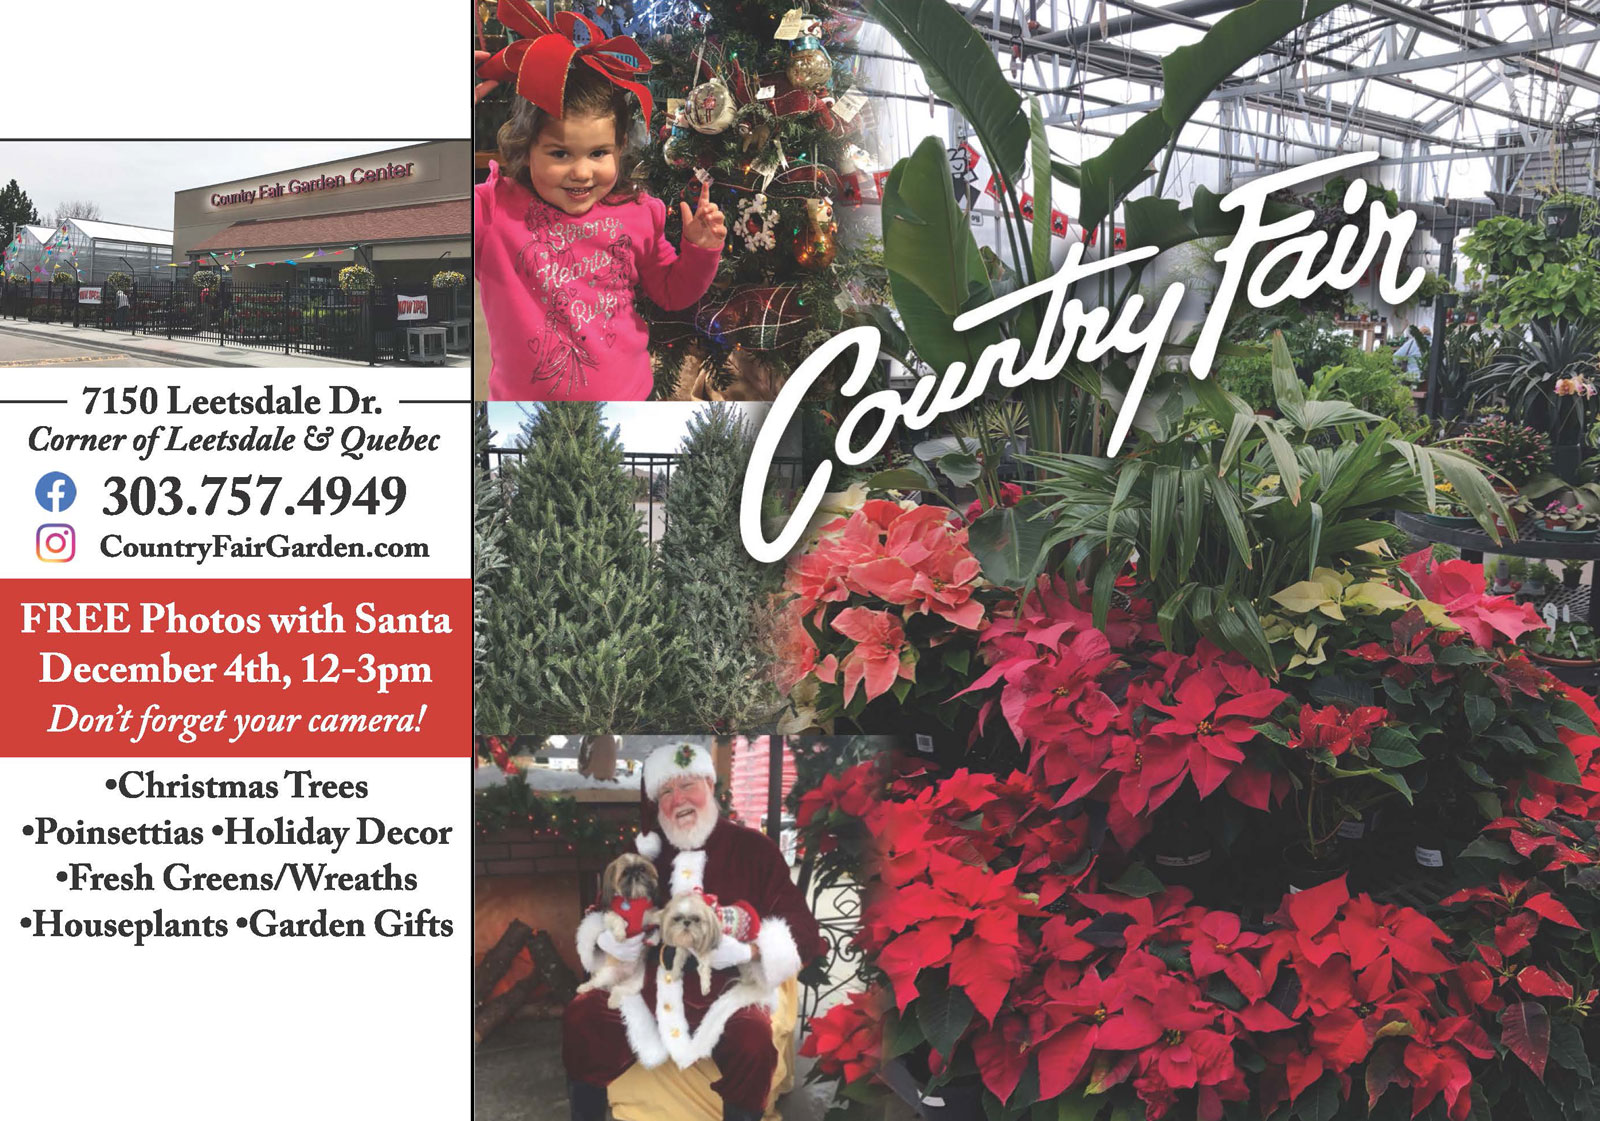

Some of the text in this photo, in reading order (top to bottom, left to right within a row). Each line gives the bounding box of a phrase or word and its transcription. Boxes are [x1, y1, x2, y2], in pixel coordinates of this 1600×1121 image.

[211, 162, 414, 206] Country Fair Garden Center
[536, 250, 612, 292] Hearts
[571, 292, 617, 332] Rule
[740, 151, 1426, 563] Country Fair
[82, 385, 382, 415] 7150 Leetsdale Dr.
[28, 425, 441, 461] Corner of Leetsdale & Quebec
[102, 474, 407, 516] 303.757.4949
[100, 533, 430, 565] CountryFairGarden.com
[21, 601, 453, 634] FREE Photos with Santa
[39, 651, 433, 694] December 4th, 12-3pm
[47, 703, 428, 744] Don’t forget your camera!
[284, 769, 369, 799] Trees
[356, 817, 453, 845] Decor
[163, 862, 418, 891] Greens/Wreaths
[374, 908, 454, 938] Gifts
